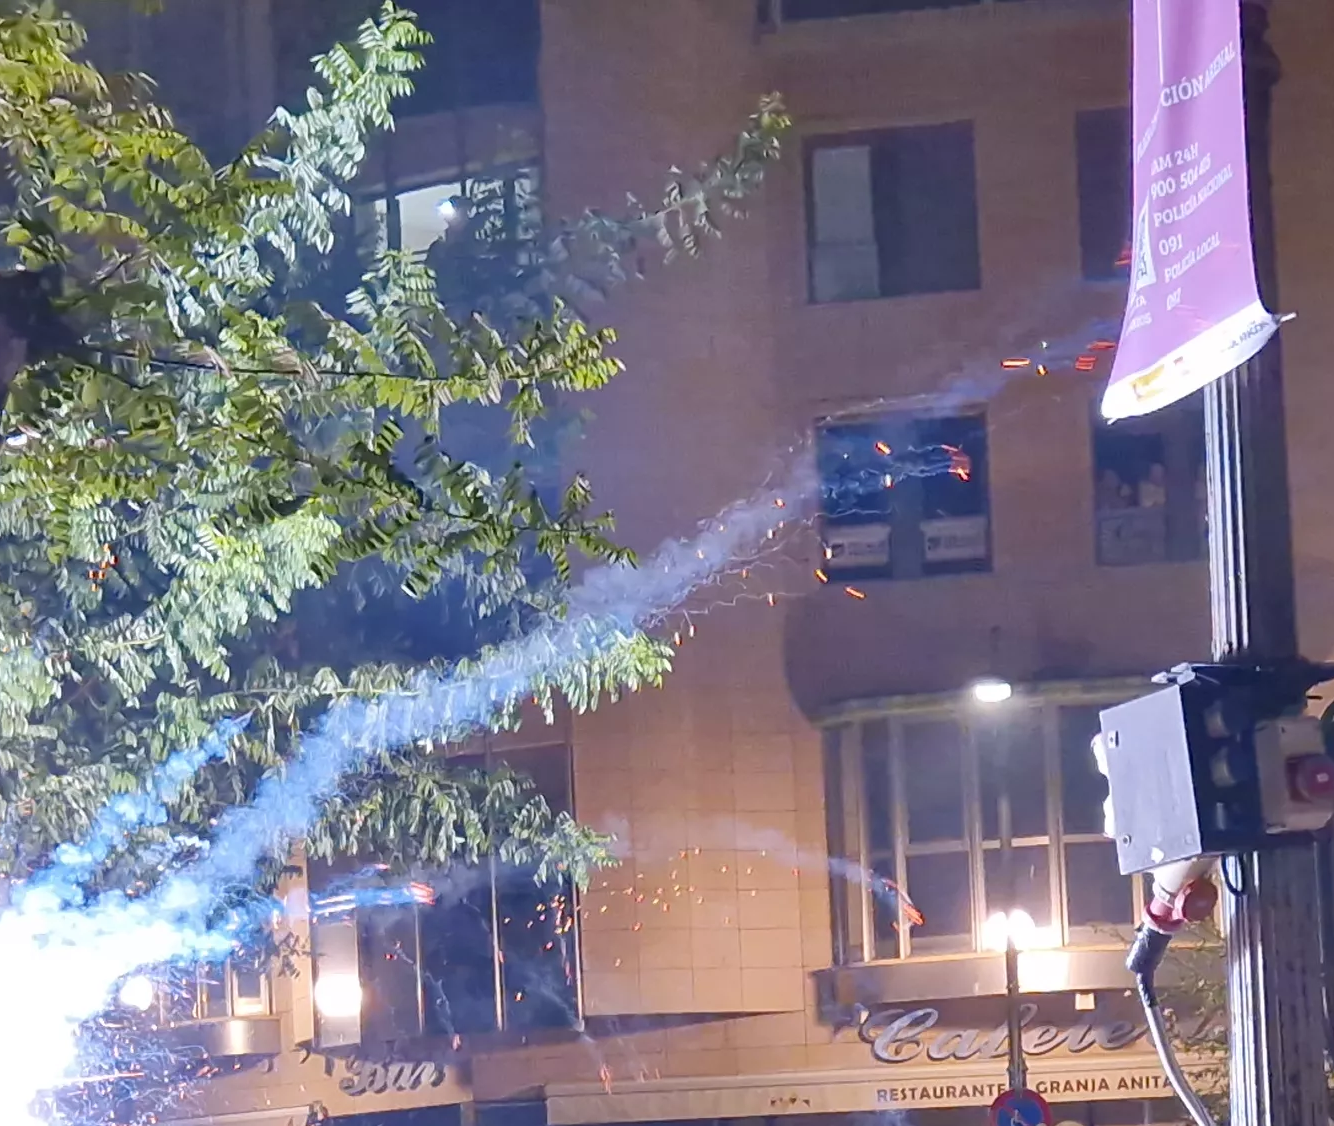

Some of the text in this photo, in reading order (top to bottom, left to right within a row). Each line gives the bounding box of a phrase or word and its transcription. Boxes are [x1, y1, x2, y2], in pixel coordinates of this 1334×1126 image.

[1150, 177, 1175, 201] 900
[1158, 233, 1183, 256] 091
[876, 1083, 1006, 1103] RESTAURANTE
[1035, 1078, 1110, 1095] GRANJA
